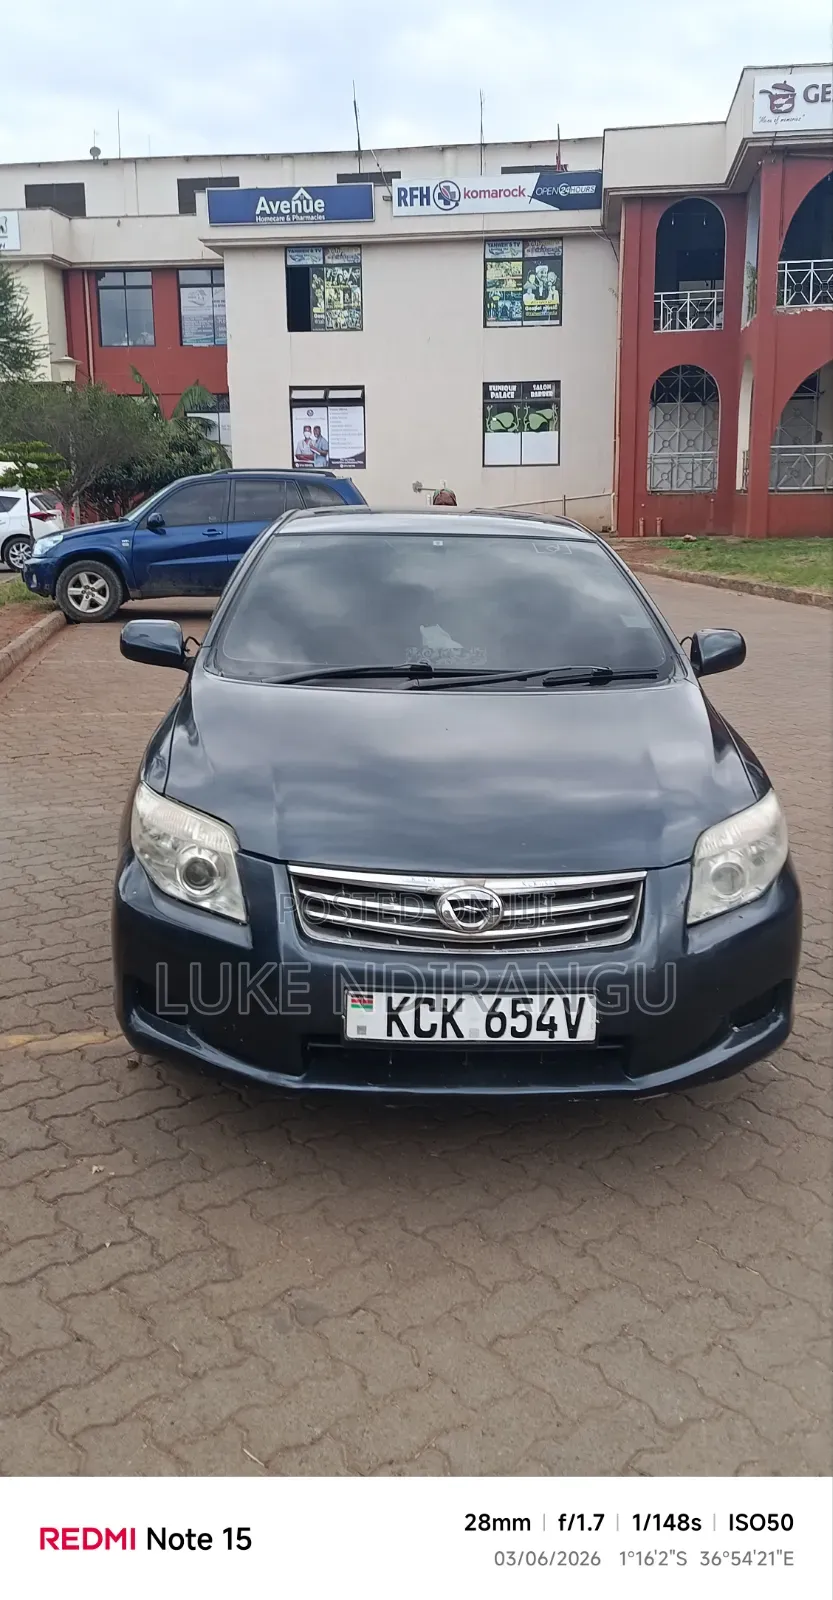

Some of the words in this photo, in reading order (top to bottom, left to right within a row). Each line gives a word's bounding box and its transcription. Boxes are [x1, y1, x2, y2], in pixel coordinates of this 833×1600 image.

[255, 196, 325, 215] Avenue
[397, 186, 430, 207] RFH
[463, 185, 526, 199] komarock
[535, 186, 559, 196] OPEN
[570, 185, 597, 194] HOURS
[255, 215, 285, 223] Homecare
[292, 214, 326, 222] Pharmacies
[490, 391, 515, 399] PALACE
[386, 996, 465, 1039] KCK
[485, 997, 586, 1039] 654V
